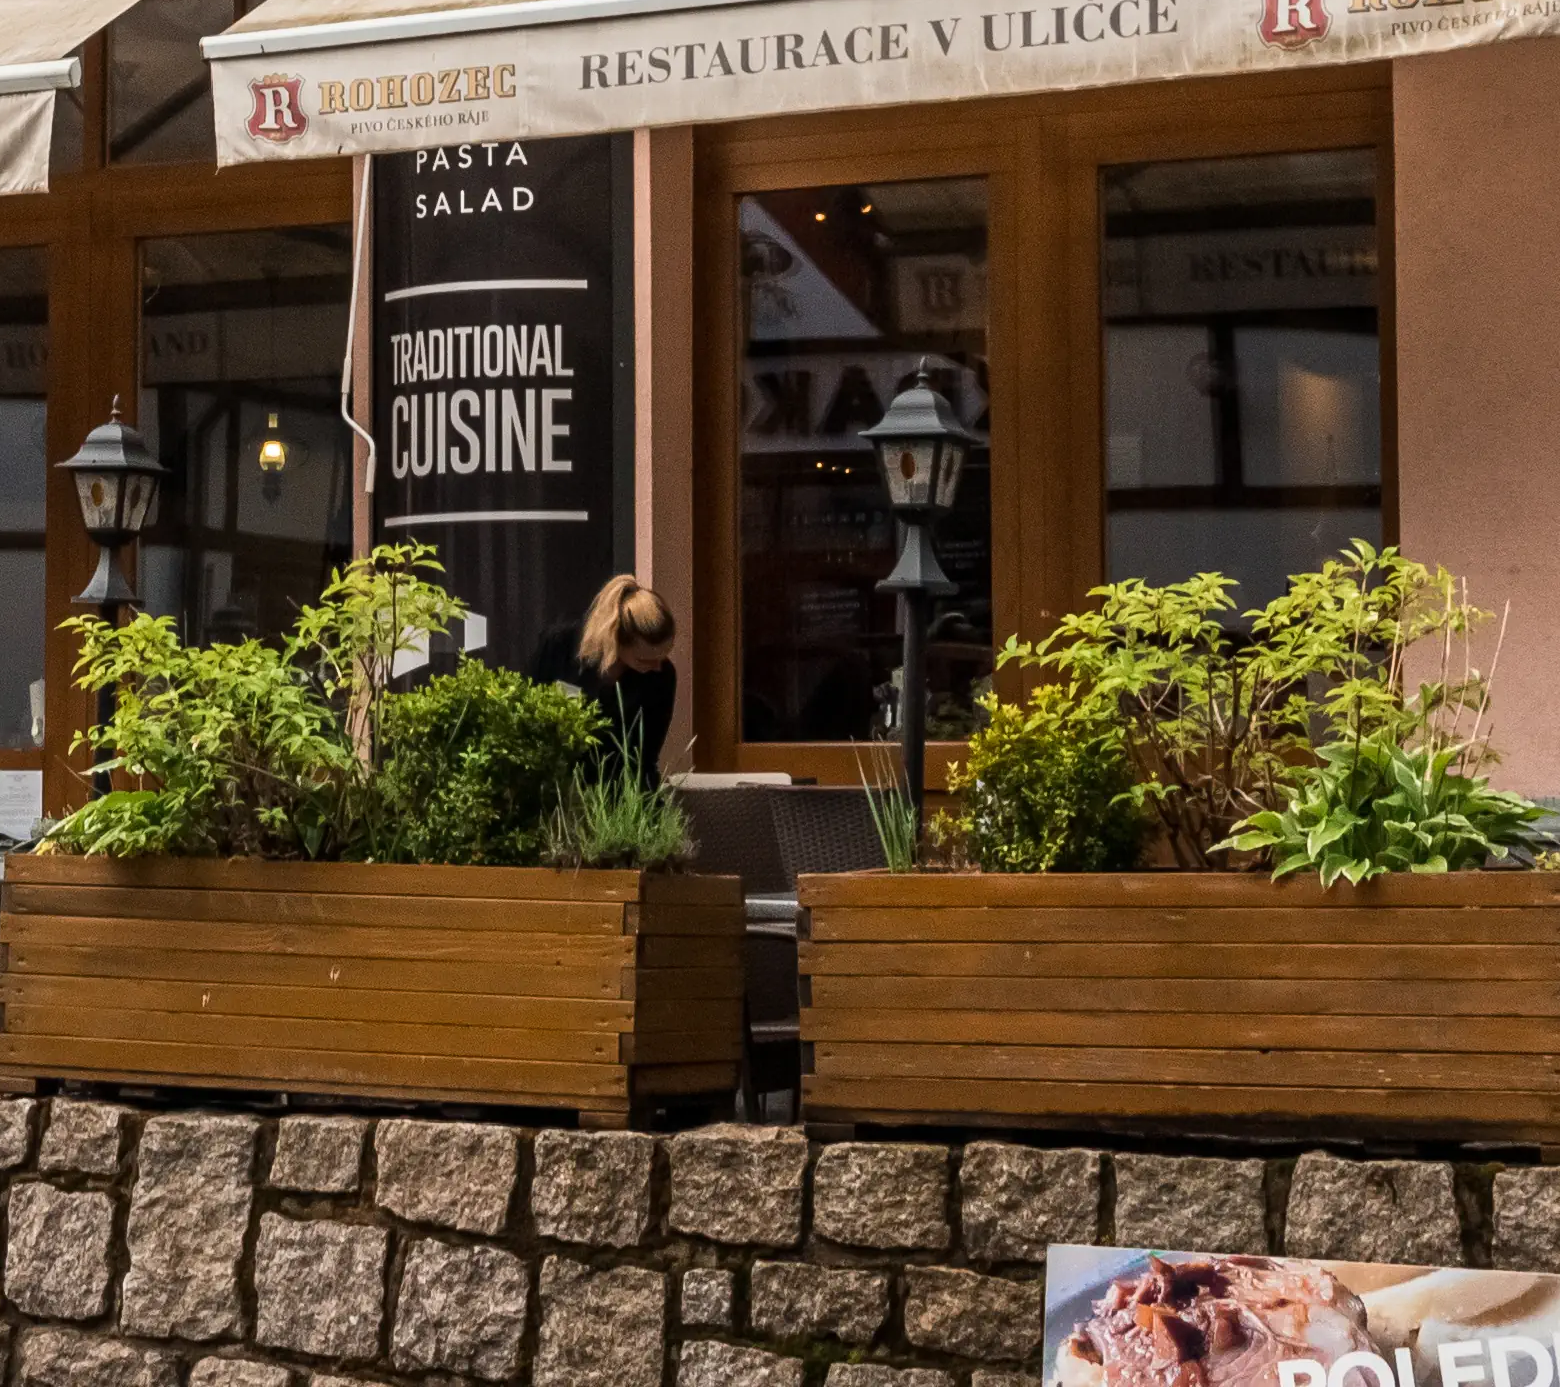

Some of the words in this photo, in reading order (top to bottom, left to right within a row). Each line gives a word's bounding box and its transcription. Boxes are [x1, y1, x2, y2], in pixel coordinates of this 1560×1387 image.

[1391, 19, 1433, 37] PIVO
[579, 22, 910, 92] RESTAURACE
[927, 19, 975, 57] V
[258, 86, 299, 129] R
[317, 63, 517, 115] ROHOZEC
[350, 122, 384, 135] PIVO
[386, 114, 453, 132] ČESKÉHO
[458, 109, 490, 127] RÁJE
[415, 141, 529, 174] PASTA
[415, 186, 535, 219] SALAD
[390, 323, 575, 386] TRADITIONAL
[390, 388, 574, 480] CUISINE
